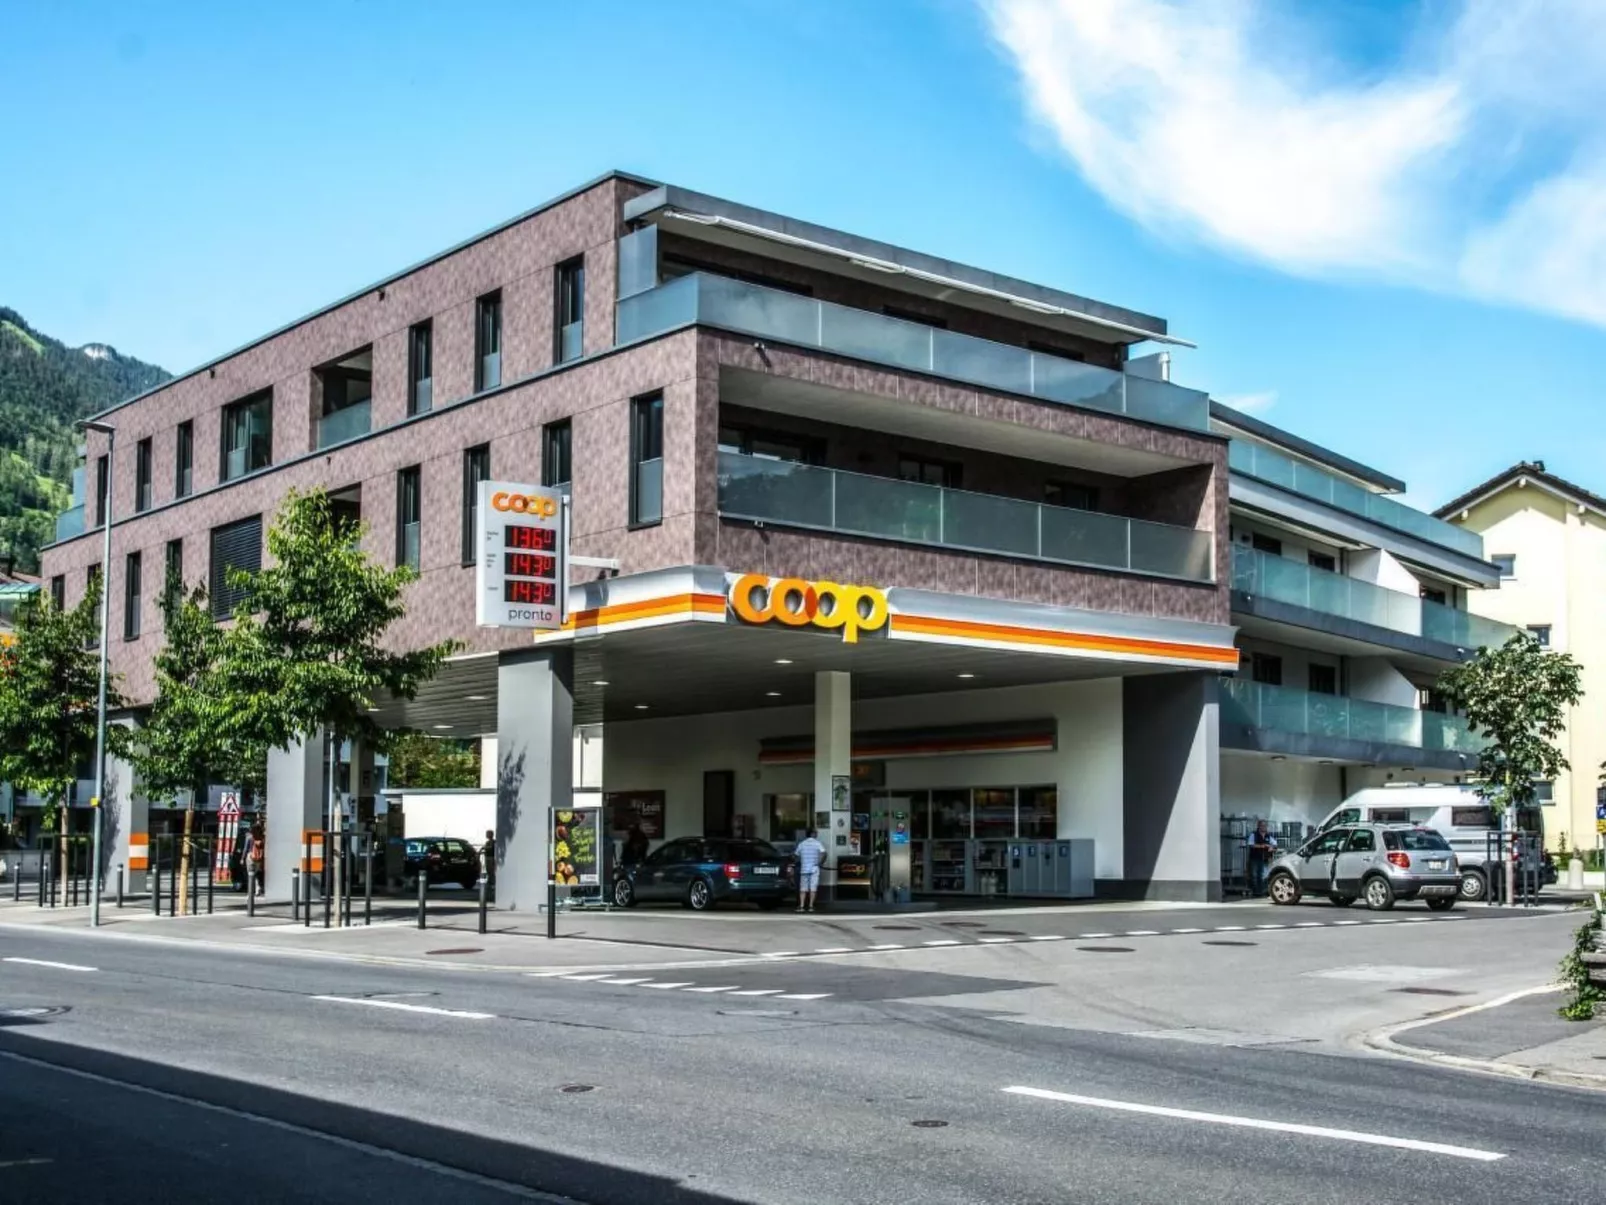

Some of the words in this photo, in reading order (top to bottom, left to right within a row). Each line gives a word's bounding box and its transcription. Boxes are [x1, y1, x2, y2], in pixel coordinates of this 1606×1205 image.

[492, 491, 557, 521] coop
[508, 608, 553, 621] pronto
[731, 573, 888, 643] coop
